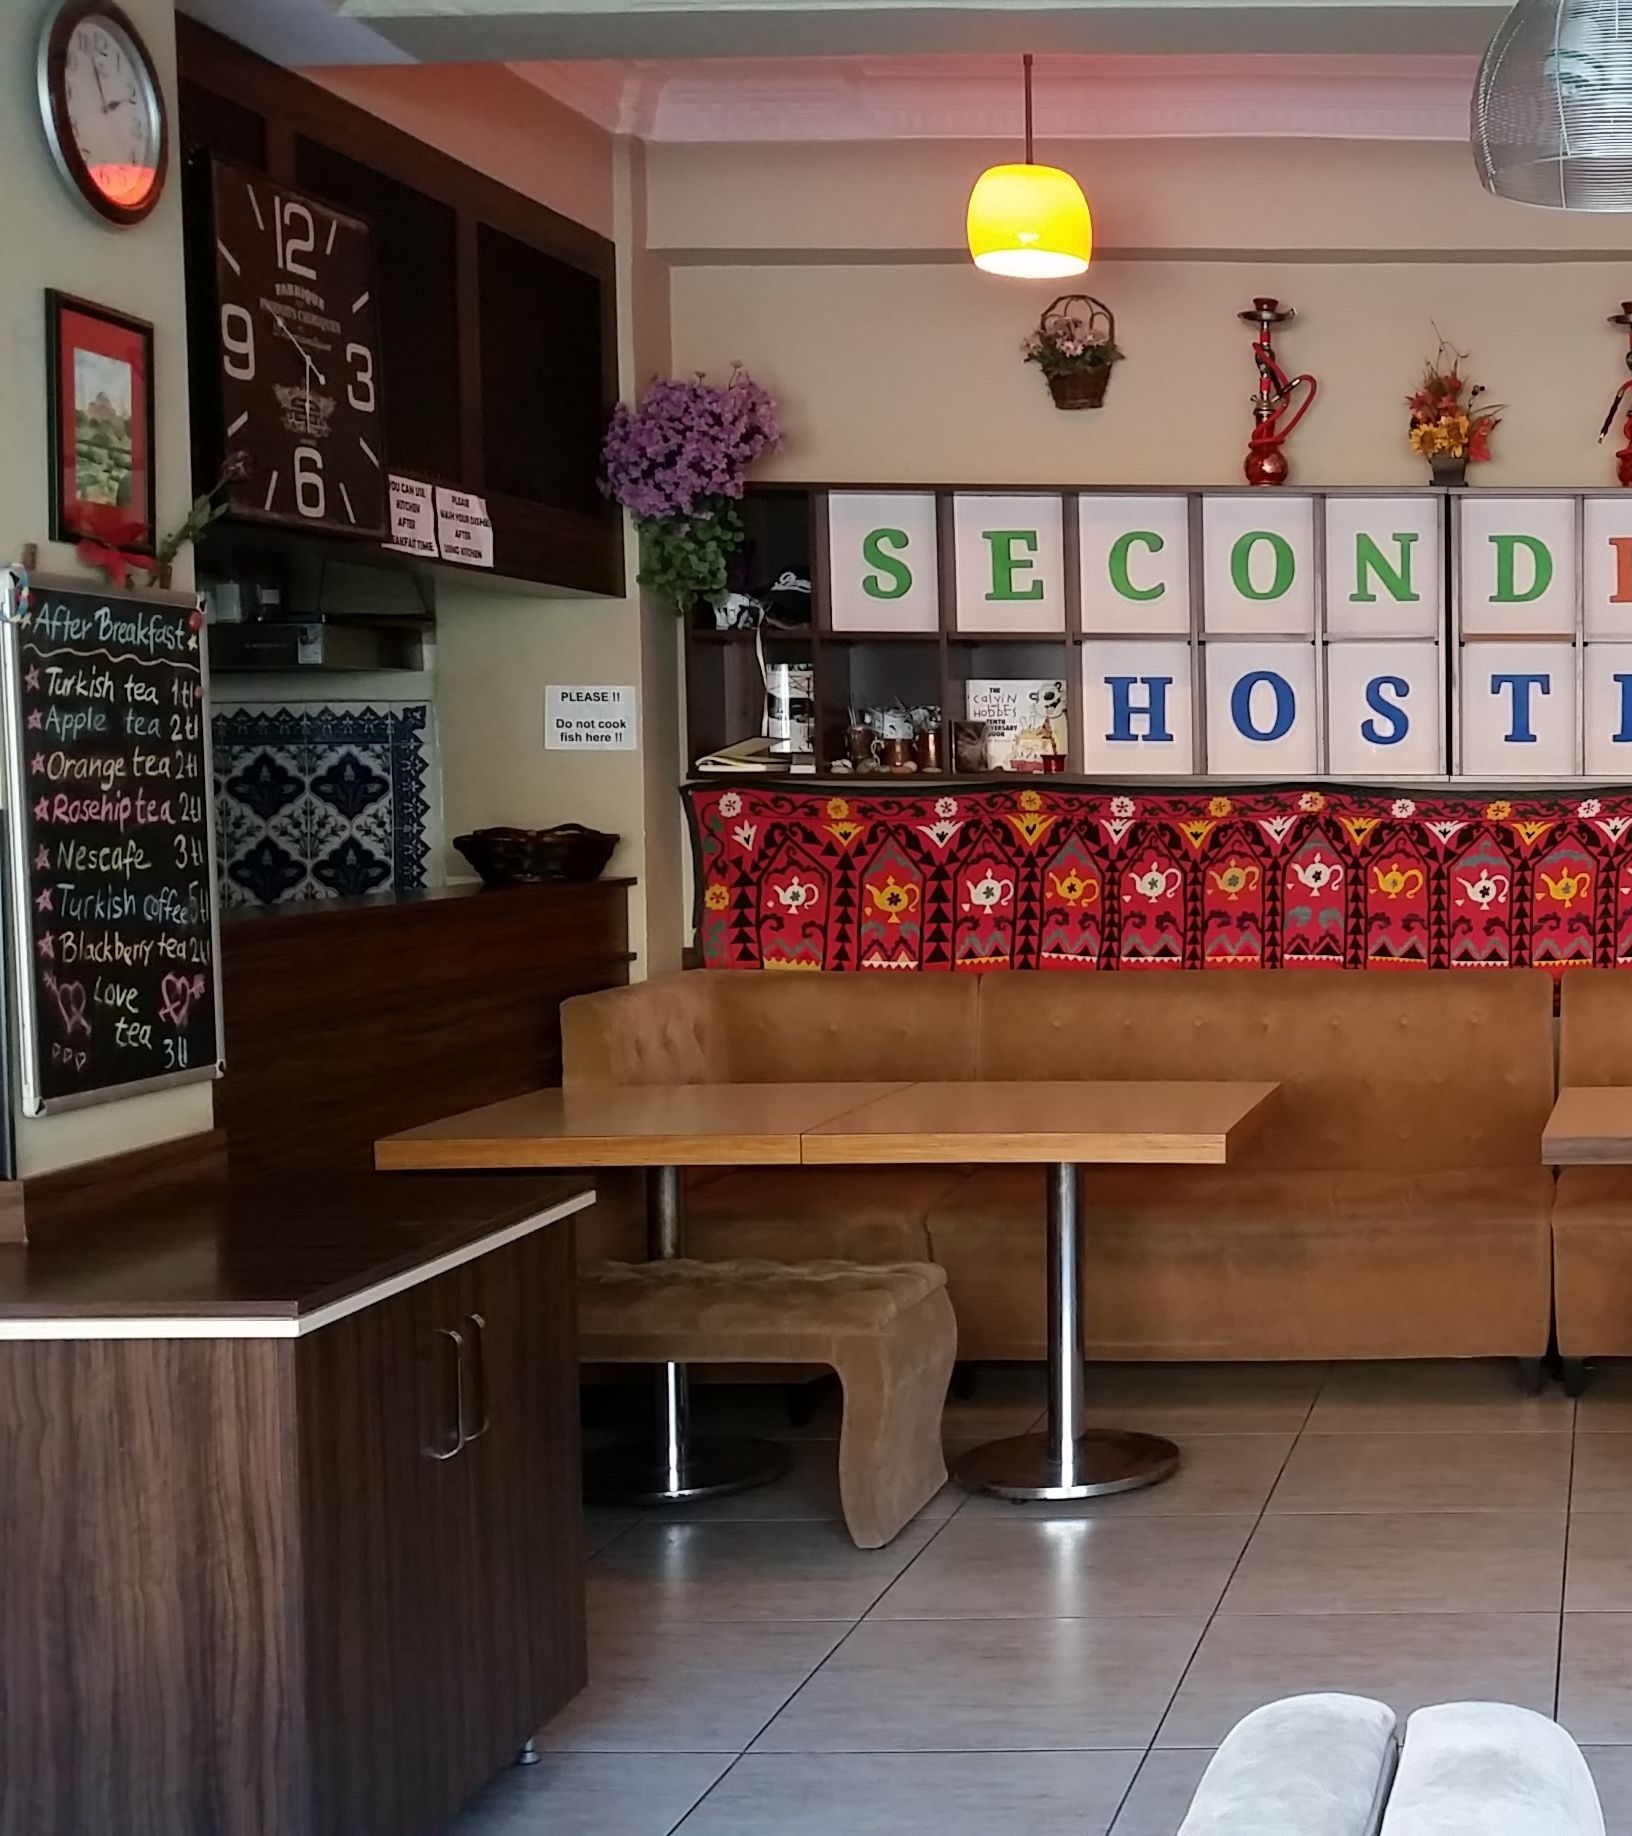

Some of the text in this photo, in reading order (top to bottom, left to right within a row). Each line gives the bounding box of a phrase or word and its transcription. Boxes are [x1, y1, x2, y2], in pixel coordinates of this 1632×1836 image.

[273, 195, 318, 281] 12
[221, 303, 256, 381] 9
[346, 343, 375, 413] 3
[294, 446, 326, 518] 6
[401, 483, 415, 495] CAN
[397, 517, 416, 529] AFTER
[417, 540, 434, 552] TIME
[861, 528, 1553, 603] SECOND
[33, 602, 186, 654] After Breakfast
[45, 665, 115, 703] Turkish
[124, 674, 160, 705] tea
[561, 692, 609, 702] PLEASE
[45, 705, 106, 741] Apple
[126, 707, 160, 738] tea
[556, 719, 626, 729] Do not cook
[560, 732, 582, 742] fish
[585, 732, 611, 742] here
[47, 751, 126, 791] Orange
[132, 746, 171, 779] tea
[52, 790, 131, 834] Rosehip
[135, 787, 176, 825] tea
[57, 839, 152, 880] Nescafe
[56, 883, 136, 921] Turkish
[143, 886, 188, 924] coffee
[58, 929, 154, 967] Blackberry
[158, 932, 186, 960] tea
[93, 976, 140, 1013] Love
[115, 1016, 152, 1049] tea
